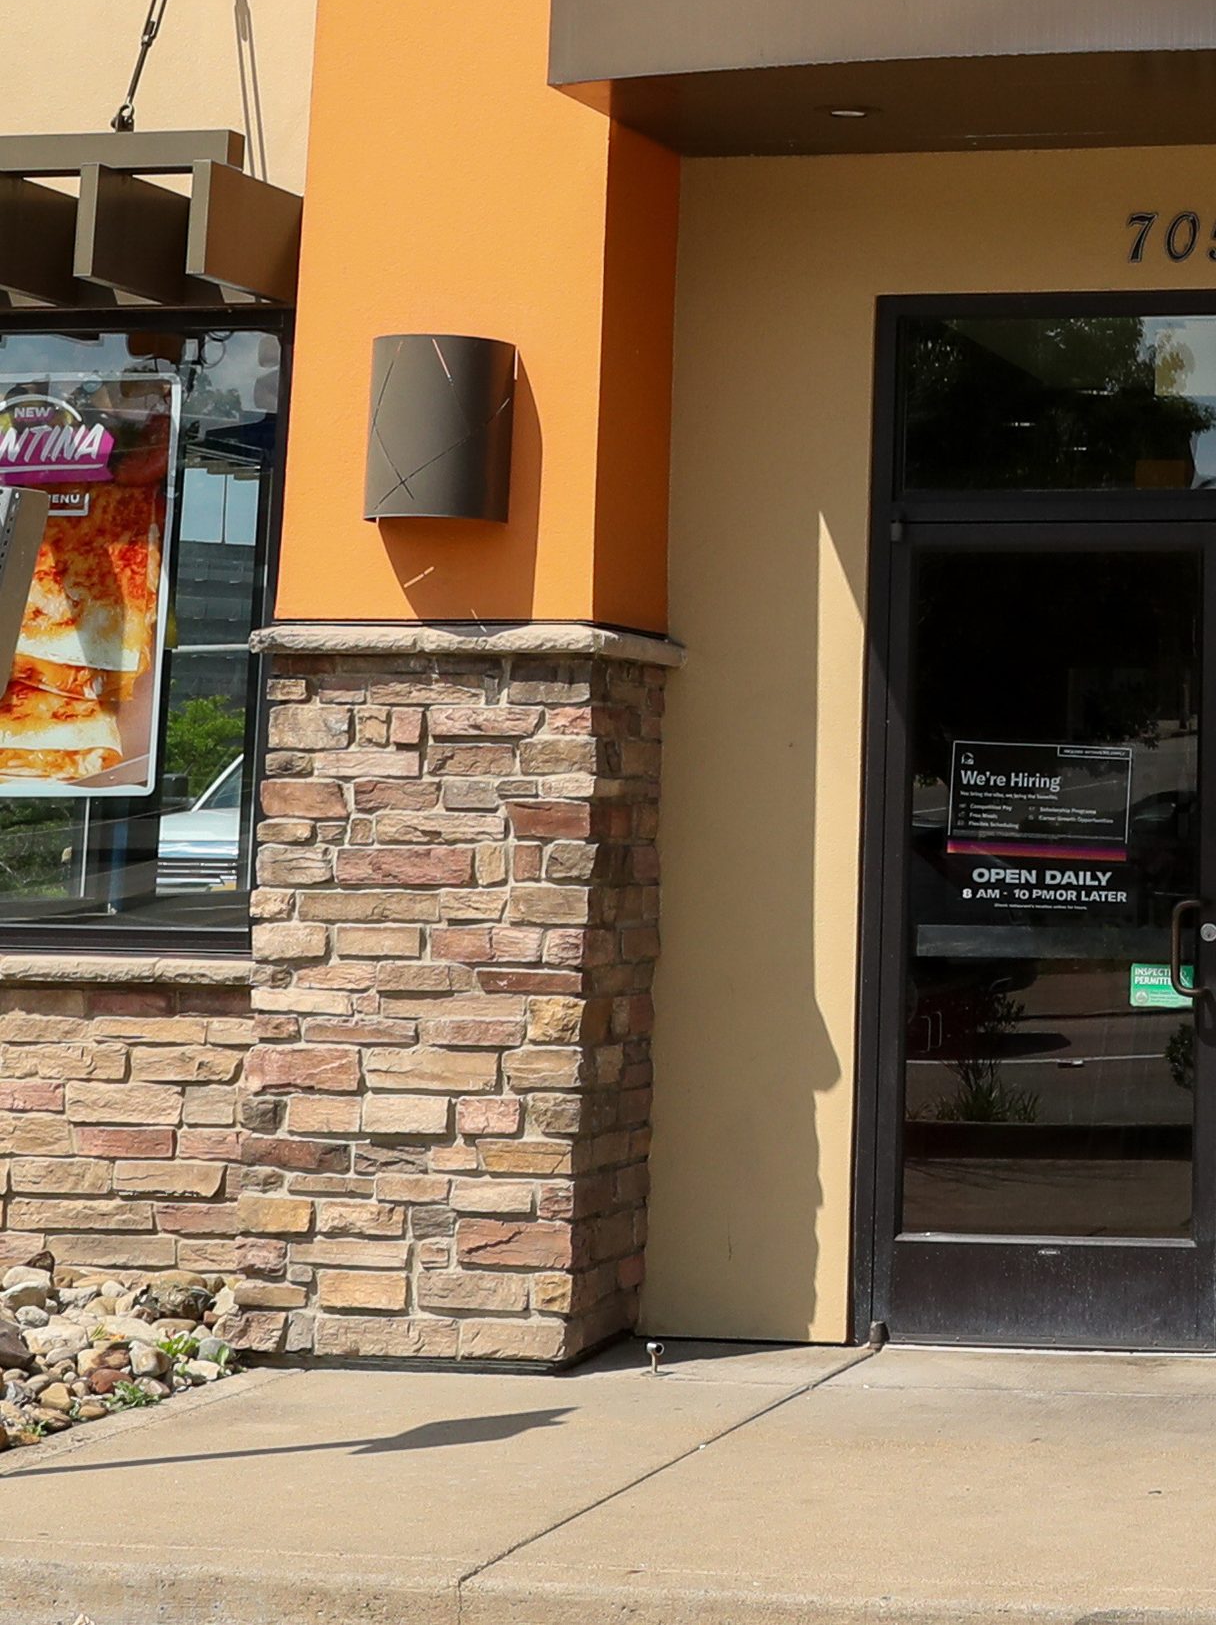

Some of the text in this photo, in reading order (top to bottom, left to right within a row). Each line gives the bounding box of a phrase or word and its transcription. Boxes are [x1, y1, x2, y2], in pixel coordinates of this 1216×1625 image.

[14, 406, 51, 418] NEW
[960, 769, 1062, 792] We're Hiring
[971, 867, 1113, 887] OPEN DAILY
[961, 888, 973, 899] 8
[976, 889, 1000, 899] AM
[1013, 889, 1029, 900] 10
[1080, 890, 1127, 903] LATER
